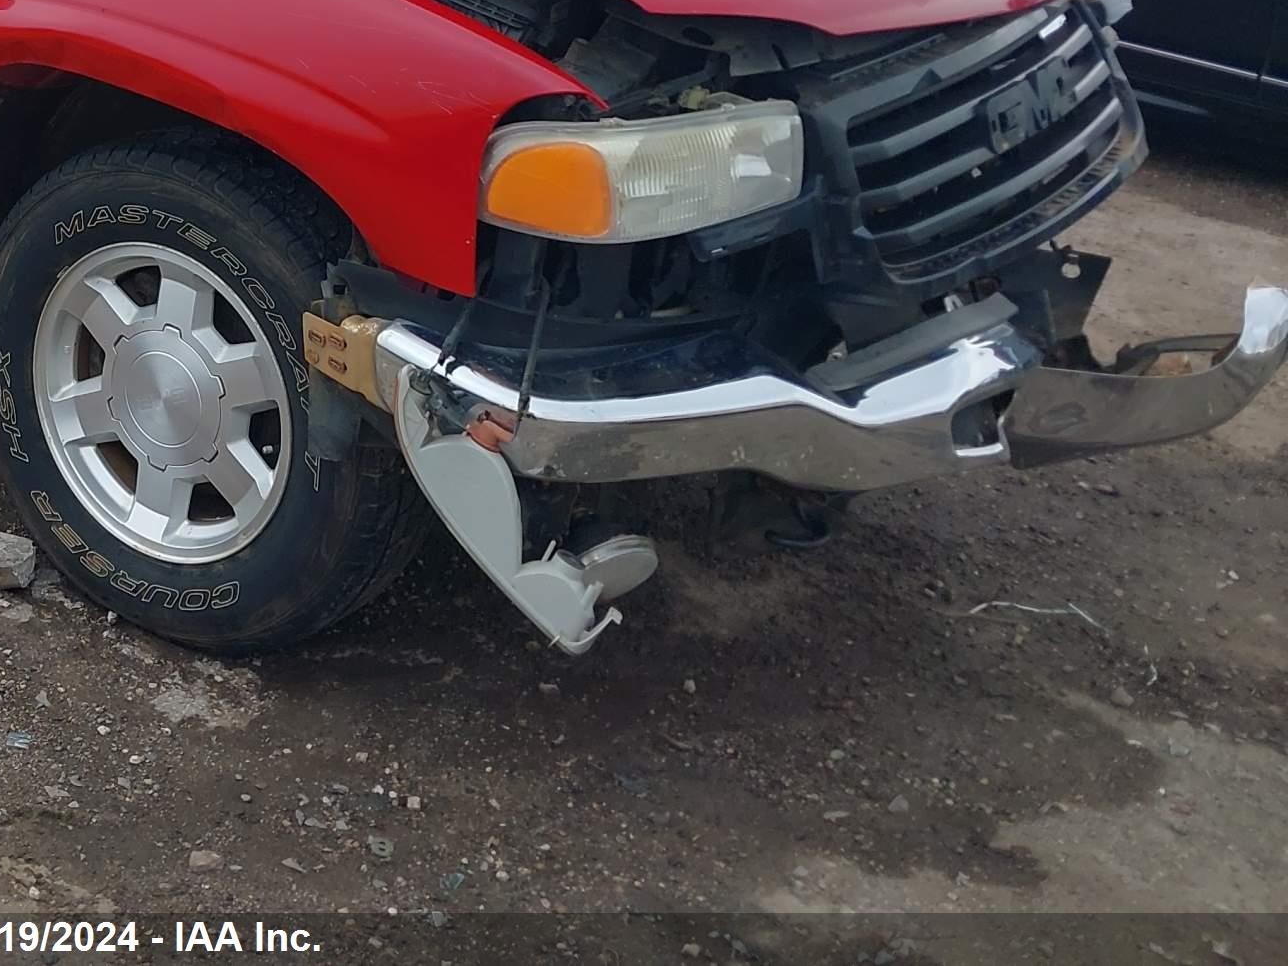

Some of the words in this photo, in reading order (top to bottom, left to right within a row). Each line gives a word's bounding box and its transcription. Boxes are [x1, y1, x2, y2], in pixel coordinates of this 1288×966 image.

[987, 57, 1078, 154] GMC
[54, 204, 322, 492] MASTERCRAT
[31, 491, 240, 610] COURSER
